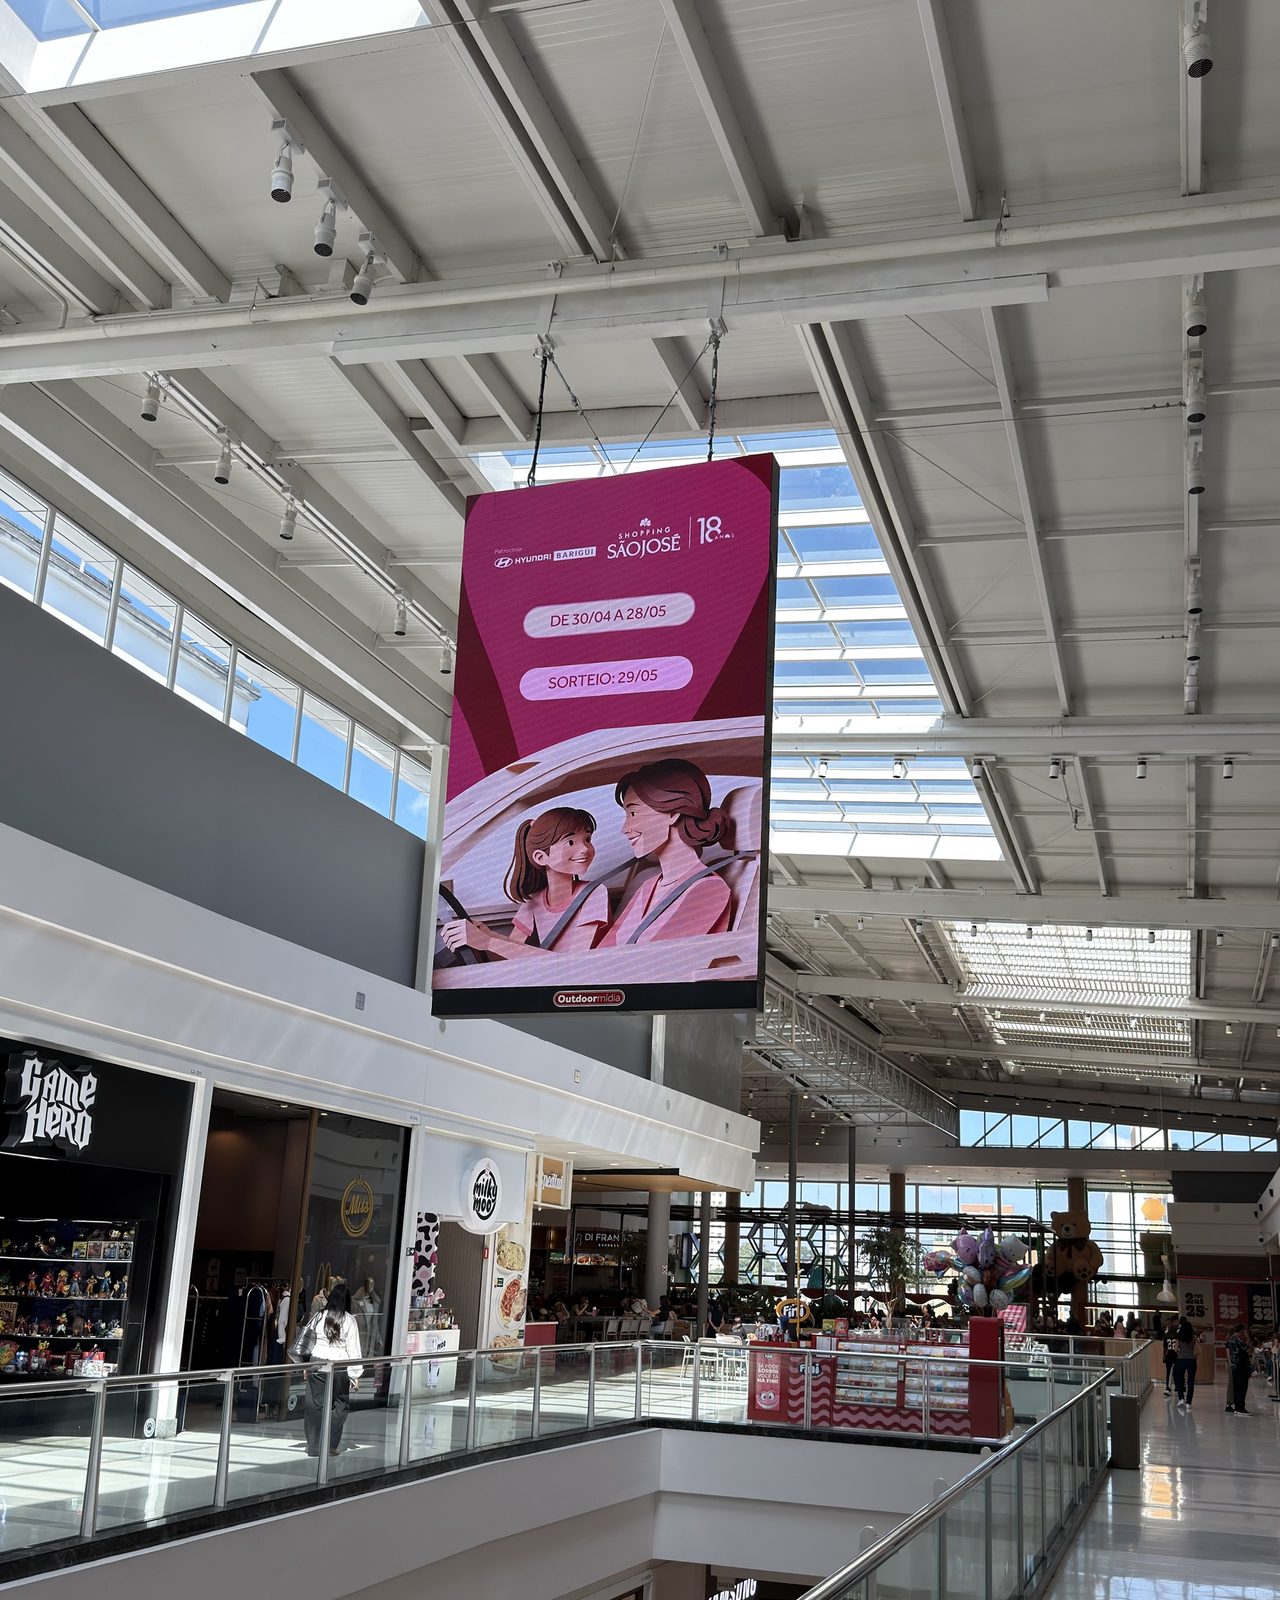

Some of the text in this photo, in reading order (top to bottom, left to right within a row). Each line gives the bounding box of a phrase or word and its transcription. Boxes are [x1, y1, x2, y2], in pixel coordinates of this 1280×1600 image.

[618, 526, 671, 540] SHOPPING
[697, 516, 722, 544] 18
[515, 553, 552, 565] HYUNDAI
[550, 604, 666, 627] DE 30/04 A 28/05
[548, 669, 658, 689] SORTEIO: 29/05
[473, 1178, 498, 1204] milky
[473, 1199, 492, 1213] moo
[799, 1363, 820, 1374] Fni
[708, 1578, 757, 1600] SUNG
